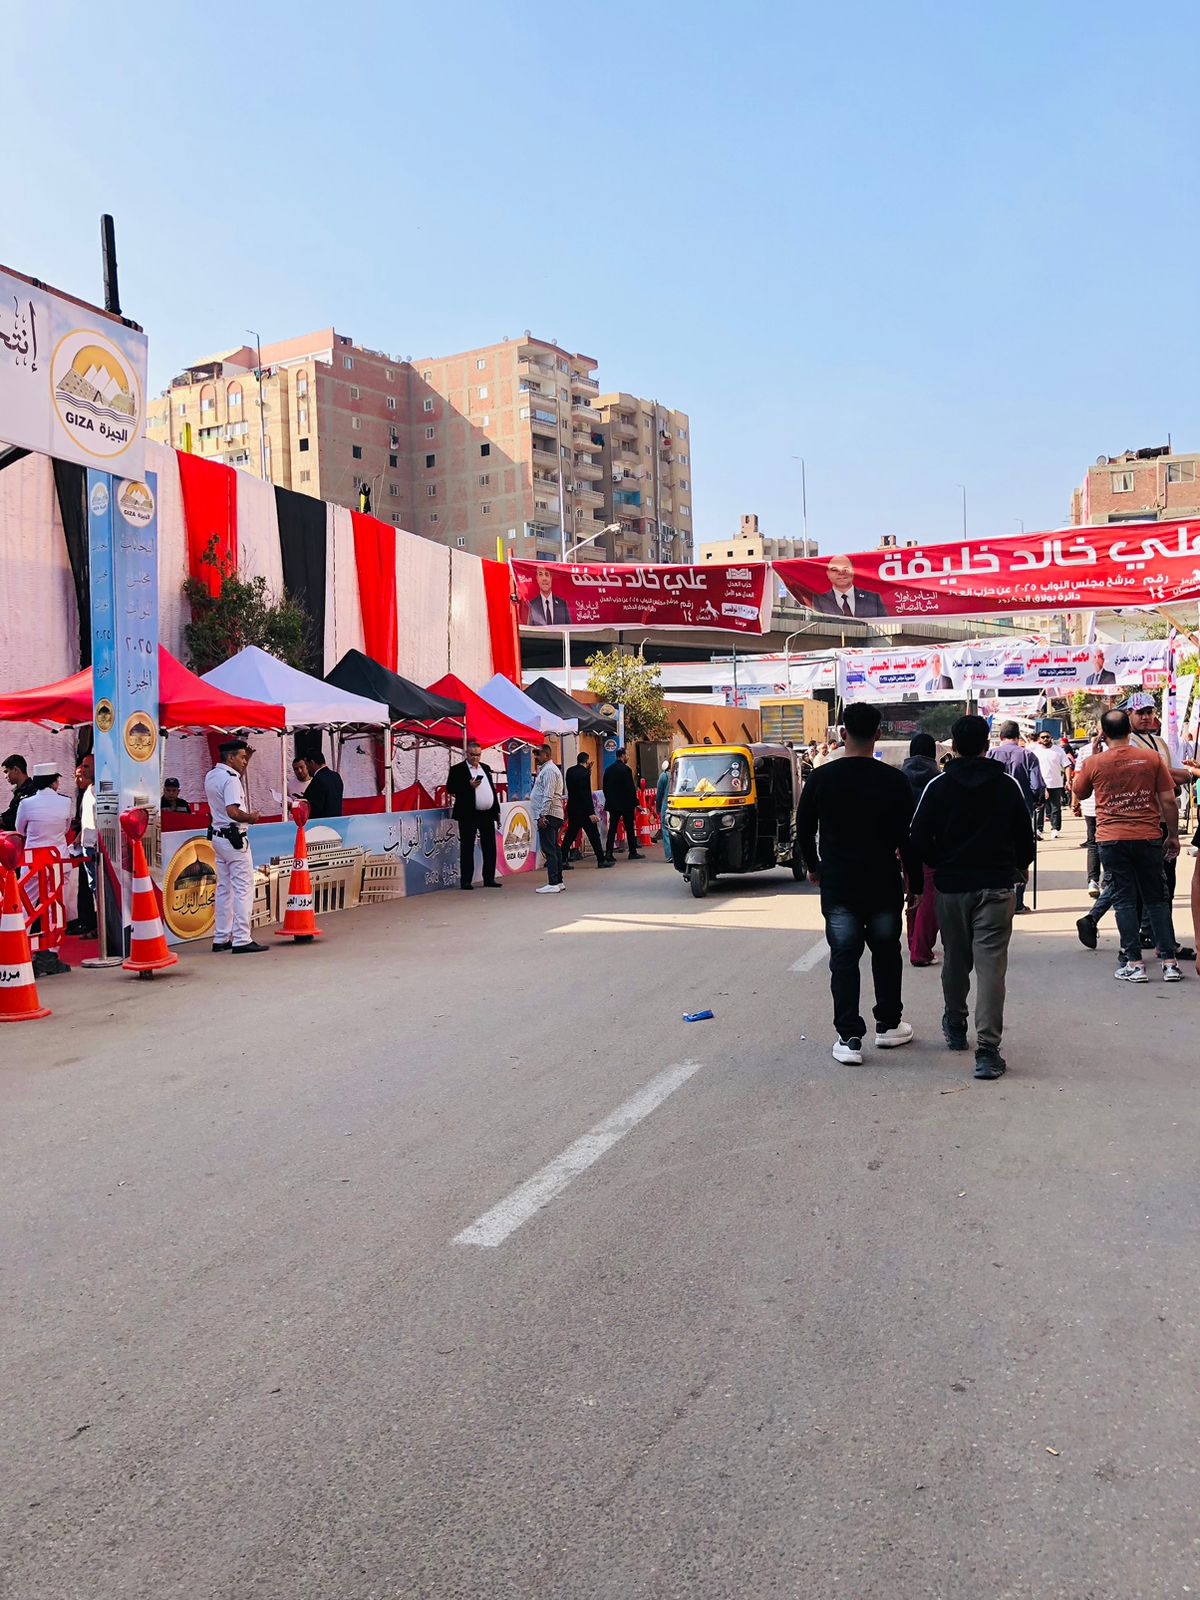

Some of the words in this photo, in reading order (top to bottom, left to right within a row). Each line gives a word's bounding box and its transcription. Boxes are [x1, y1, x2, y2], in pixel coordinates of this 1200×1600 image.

[65, 411, 94, 431] GIZA
[99, 422, 128, 442] الجيزة
[1010, 538, 1097, 571] خالد
[878, 546, 1000, 585] خليفة
[571, 567, 622, 593] خليفة
[626, 567, 660, 590] خالد
[664, 568, 708, 595] علي
[1071, 578, 1104, 590] مجلس
[1106, 574, 1135, 587] مرشح
[1143, 574, 1169, 585] رقم
[973, 586, 995, 597] حزب
[996, 585, 1011, 596] عن
[1015, 583, 1037, 593] ٢٠٢٥
[1040, 580, 1070, 592] النواب
[1149, 586, 1165, 599] ١٤
[909, 590, 938, 602] الناس
[1032, 594, 1057, 603] بولاق
[1058, 592, 1081, 602] دائرة
[680, 600, 694, 610] رقم
[683, 610, 692, 622] ١٤
[126, 637, 153, 655] ٢٠٢٥
[383, 815, 423, 858] النواب
[172, 892, 198, 915] النواب
